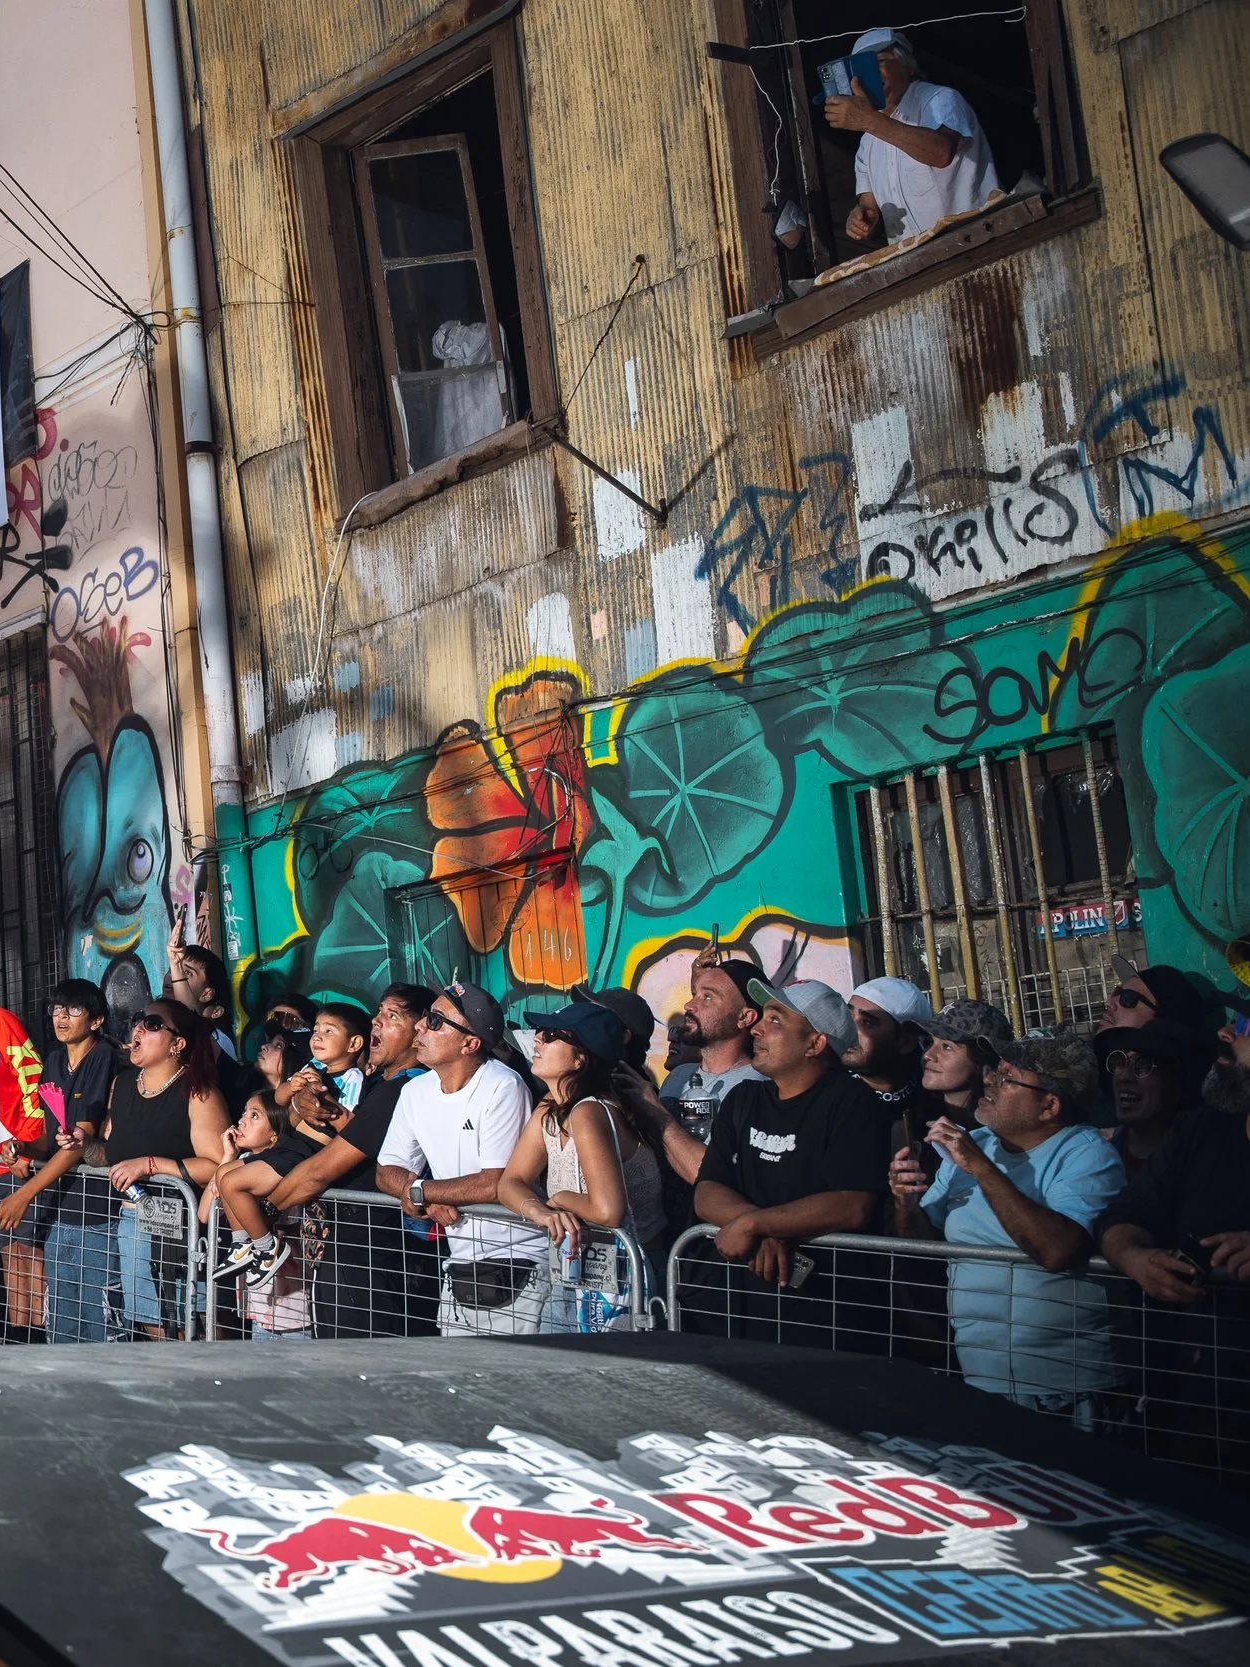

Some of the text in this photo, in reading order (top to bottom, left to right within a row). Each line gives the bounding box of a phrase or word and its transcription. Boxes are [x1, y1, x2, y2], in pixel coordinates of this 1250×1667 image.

[585, 1246, 607, 1262] DS
[650, 1462, 1148, 1550] Red Bull
[322, 1590, 900, 1667] VALPARAISO
[827, 1566, 1148, 1635] CERRO
